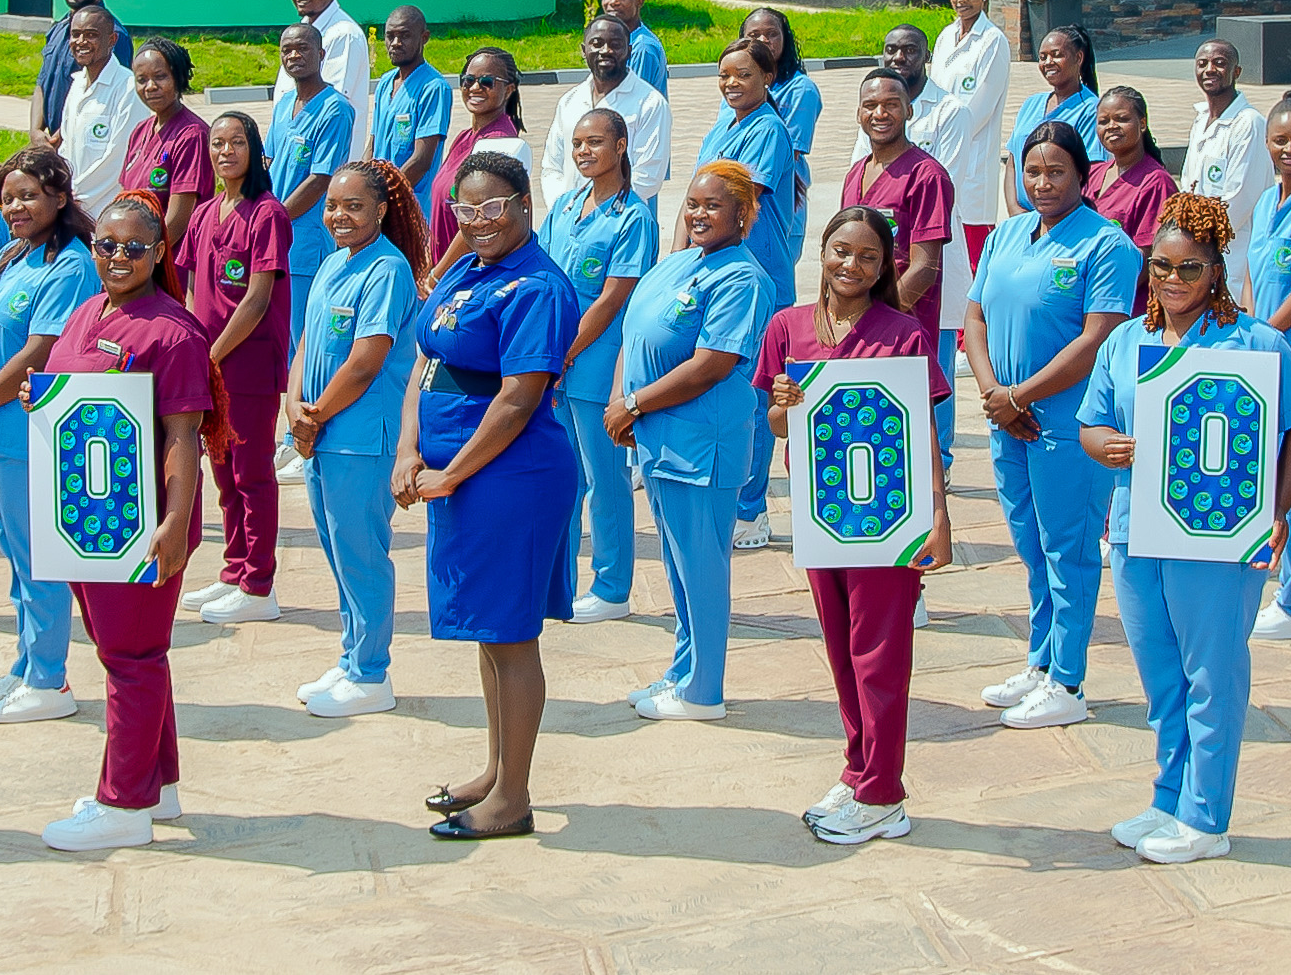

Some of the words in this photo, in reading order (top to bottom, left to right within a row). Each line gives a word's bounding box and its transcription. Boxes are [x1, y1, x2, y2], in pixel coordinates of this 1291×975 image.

[54, 397, 145, 559] 0
[807, 381, 912, 544] 0
[1160, 371, 1267, 538] 0
